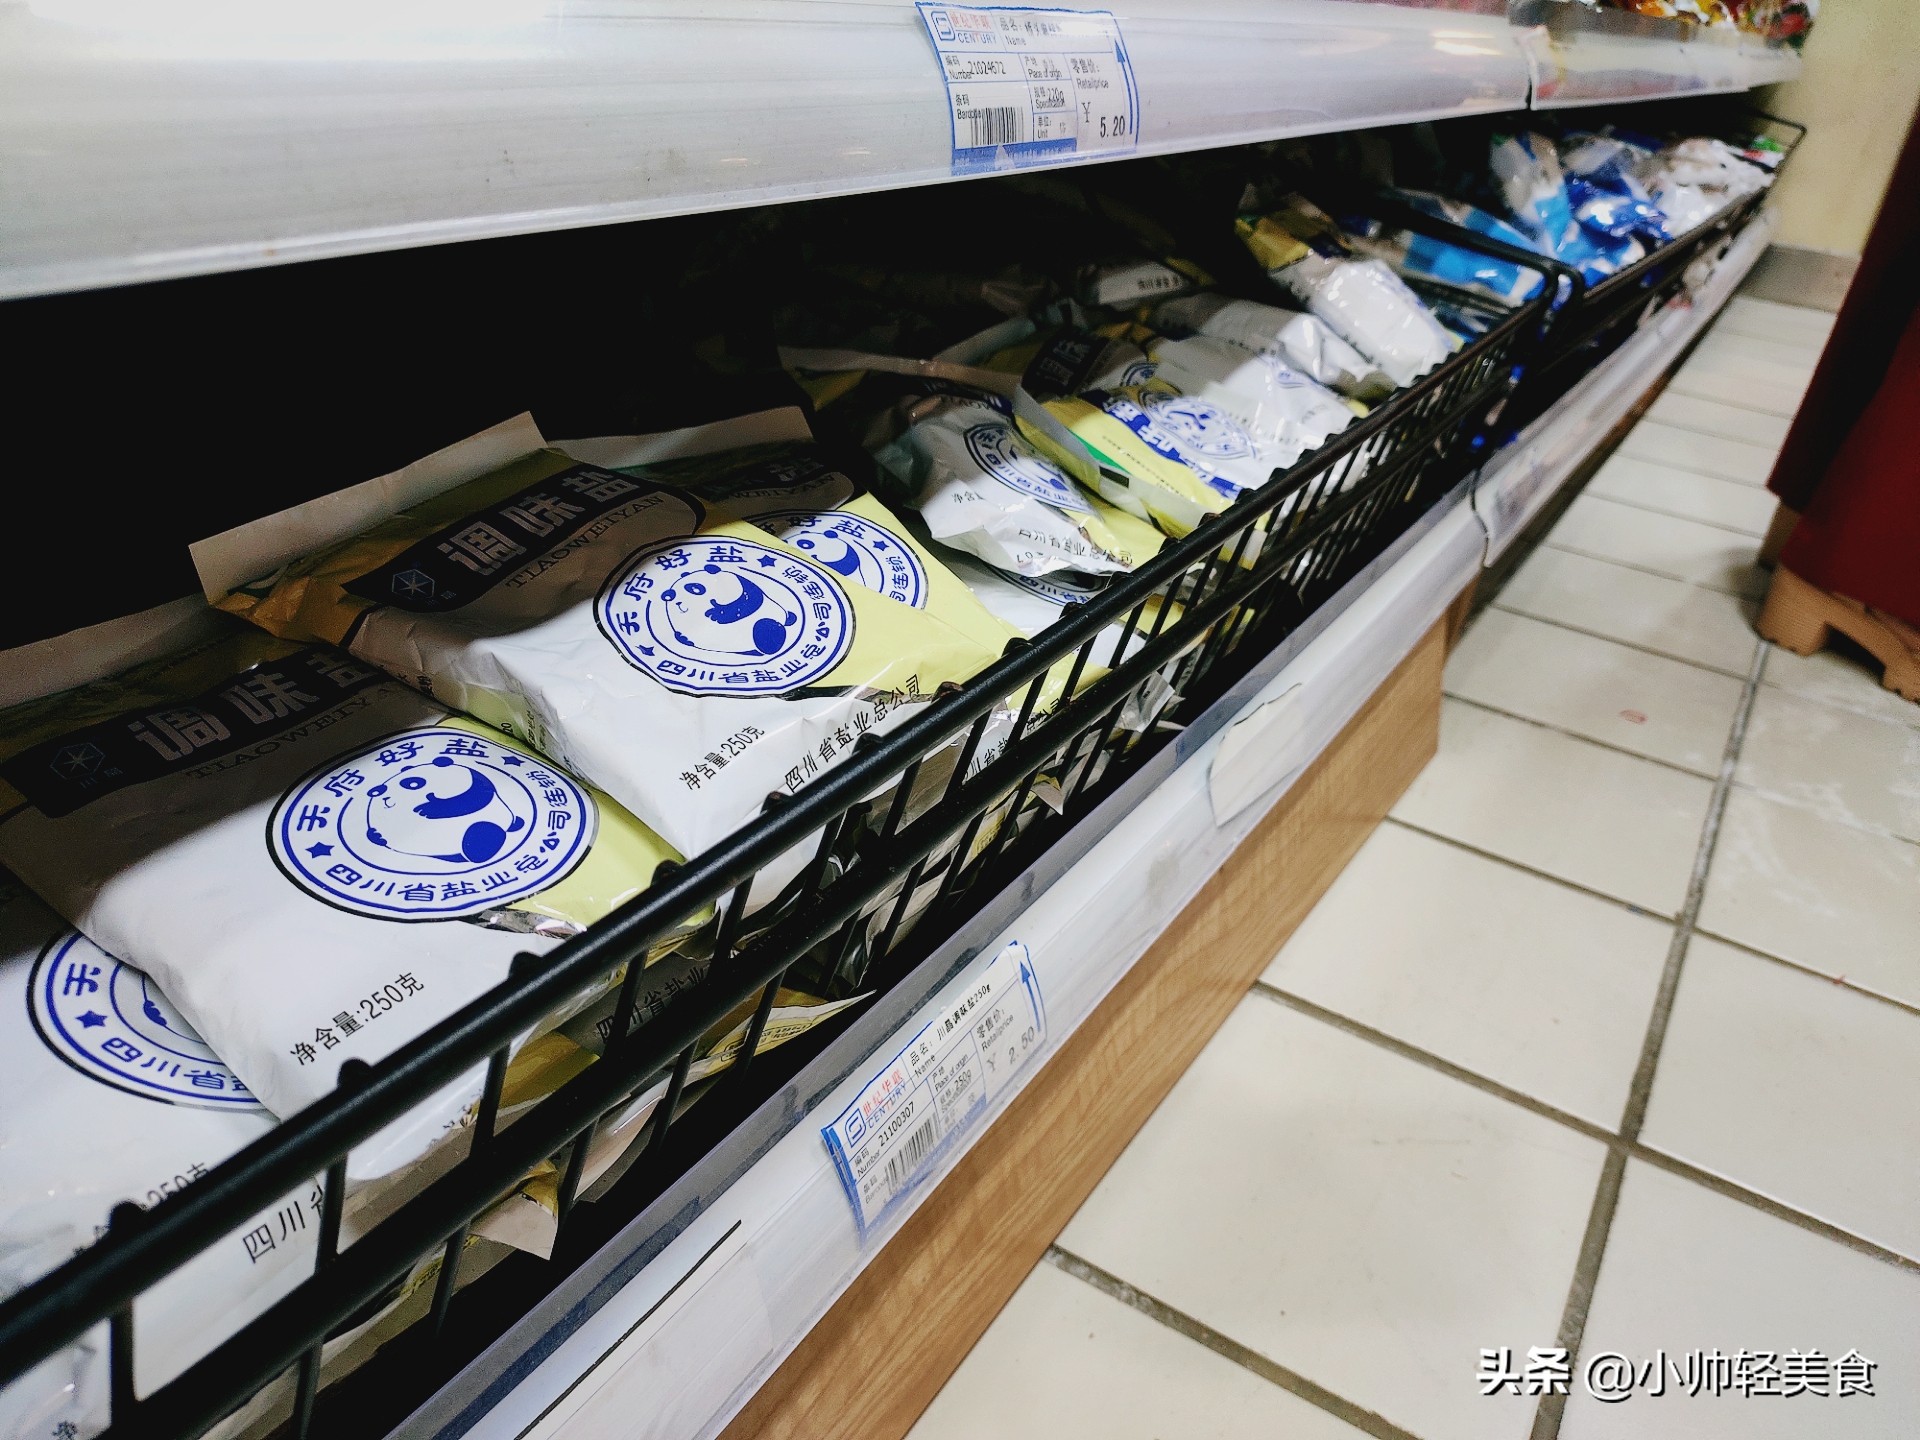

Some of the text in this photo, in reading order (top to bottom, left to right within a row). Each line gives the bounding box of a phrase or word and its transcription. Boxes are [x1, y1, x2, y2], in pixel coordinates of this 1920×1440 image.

[958, 32, 997, 44] CENTURY
[1005, 36, 1027, 46] Name
[1100, 115, 1126, 138] 5.20
[435, 469, 641, 576] 调味盐
[505, 494, 664, 588] TIAOWEIYAN
[615, 543, 749, 637] 天府好盐
[678, 724, 766, 792] 净含量:250克
[784, 673, 921, 793] 四川省盐业总公司
[295, 736, 491, 833] 天府好盐
[289, 969, 426, 1067] 净含量:250克
[914, 1055, 937, 1079] Name
[867, 1083, 908, 1129] CENTURY
[877, 1101, 915, 1148] 21100307
[857, 1149, 881, 1178] Number
